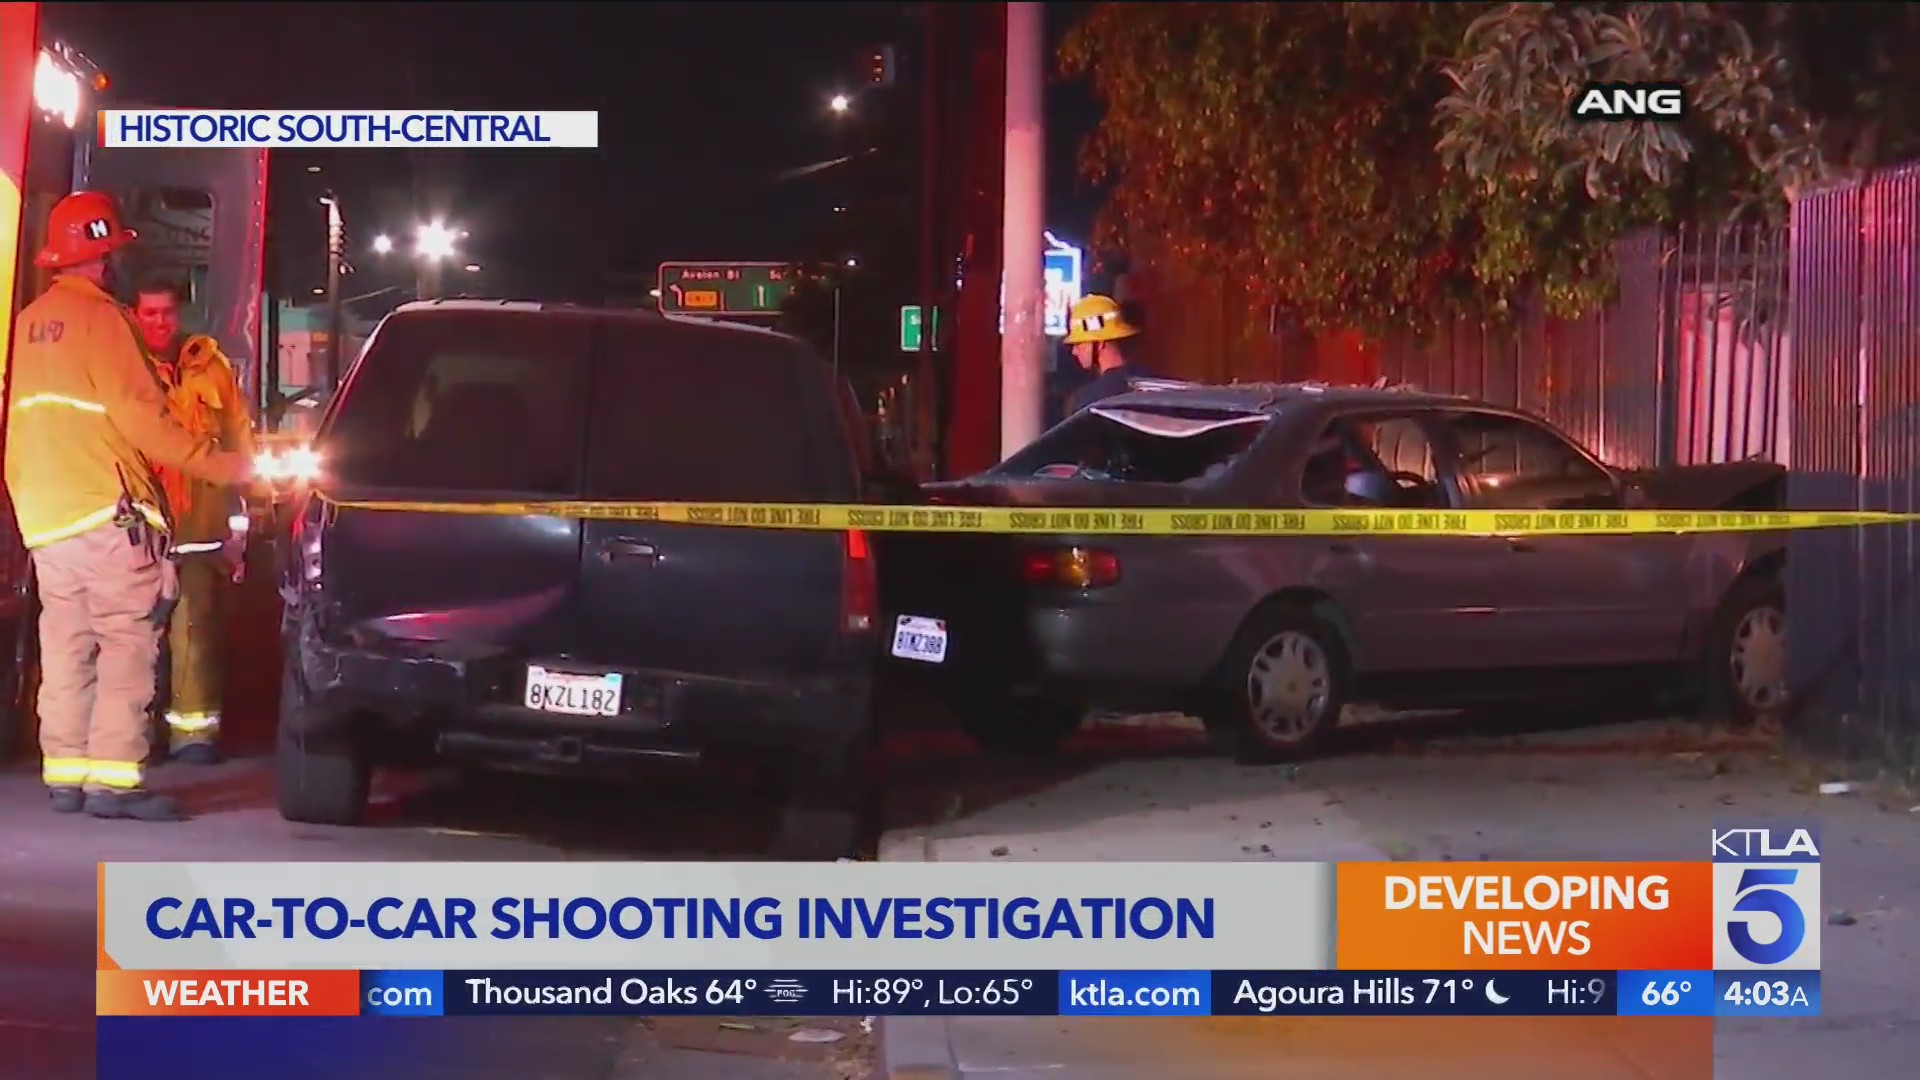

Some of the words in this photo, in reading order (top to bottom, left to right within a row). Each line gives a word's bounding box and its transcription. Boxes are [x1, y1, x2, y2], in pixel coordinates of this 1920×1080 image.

[728, 507, 748, 522] NOT
[752, 508, 766, 523] DO
[770, 508, 792, 524] LINE
[798, 508, 819, 525] FIRE
[848, 510, 884, 526] CROSS
[889, 512, 909, 526] NOT
[914, 512, 928, 526] DO
[932, 512, 954, 527] LINE
[960, 512, 981, 527] FIRE
[1009, 512, 1046, 528] CROSS
[1051, 514, 1072, 528] NOT
[1074, 514, 1089, 529] DO
[1093, 514, 1115, 529] LINE
[1122, 514, 1143, 529] FIRE
[1212, 514, 1233, 530] NOT
[1237, 514, 1251, 530] DO
[1256, 514, 1277, 530] LINE
[1283, 514, 1305, 530] FIRE
[1373, 514, 1394, 530] NOT
[1398, 514, 1412, 530] DO
[1417, 514, 1439, 530] LINE
[1444, 514, 1466, 530] FIRE
[1535, 514, 1556, 528] NOT
[1560, 514, 1574, 528] DO
[1578, 514, 1600, 528] LINE
[1606, 514, 1627, 528] FIRE
[530, 683, 616, 712] 8KZL182
